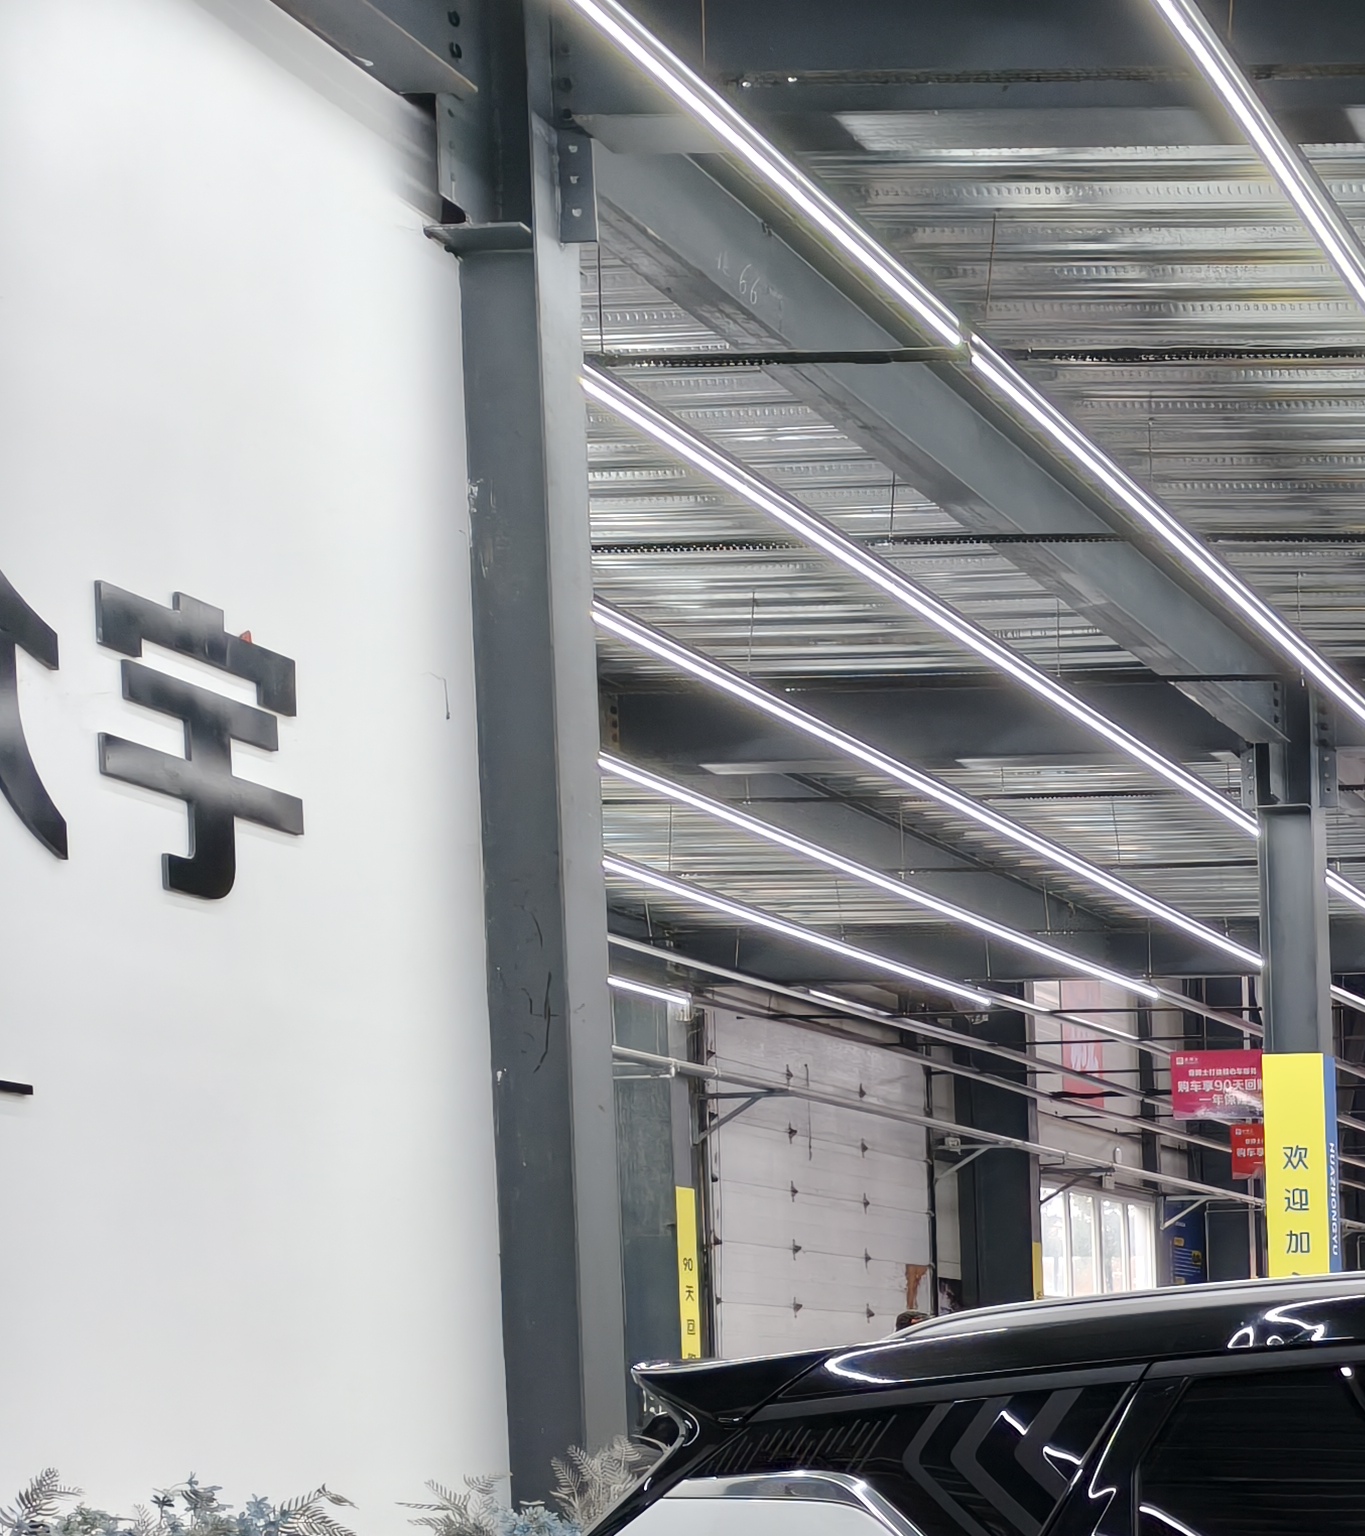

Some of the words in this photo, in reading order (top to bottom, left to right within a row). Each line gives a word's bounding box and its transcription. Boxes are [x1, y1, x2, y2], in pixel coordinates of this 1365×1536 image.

[0, 570, 304, 900] 宇
[1177, 1079, 1263, 1093] 购车享90天回
[1282, 1144, 1311, 1277] 欢迎加
